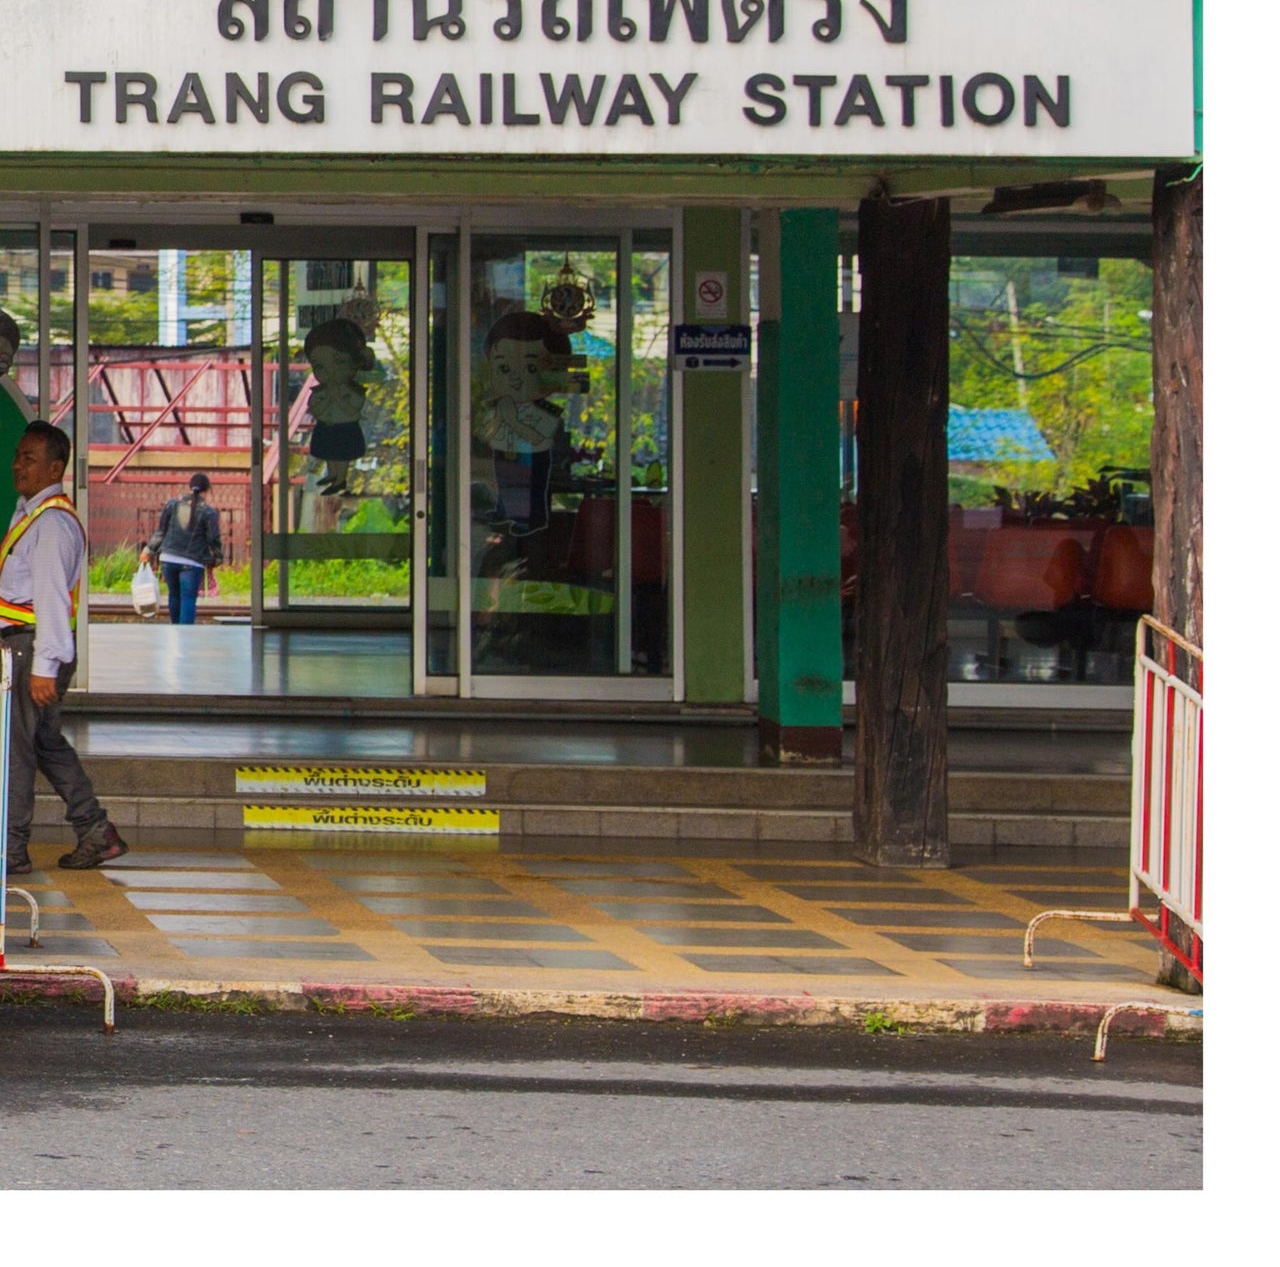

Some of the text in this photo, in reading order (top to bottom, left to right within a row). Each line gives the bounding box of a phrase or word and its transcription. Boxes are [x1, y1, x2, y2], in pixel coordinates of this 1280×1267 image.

[64, 70, 1070, 128] TRANG RAILWAY STATION
[303, 769, 422, 789] พื้นต่างระดับ
[312, 808, 433, 827] พื้นต่างระดับ
